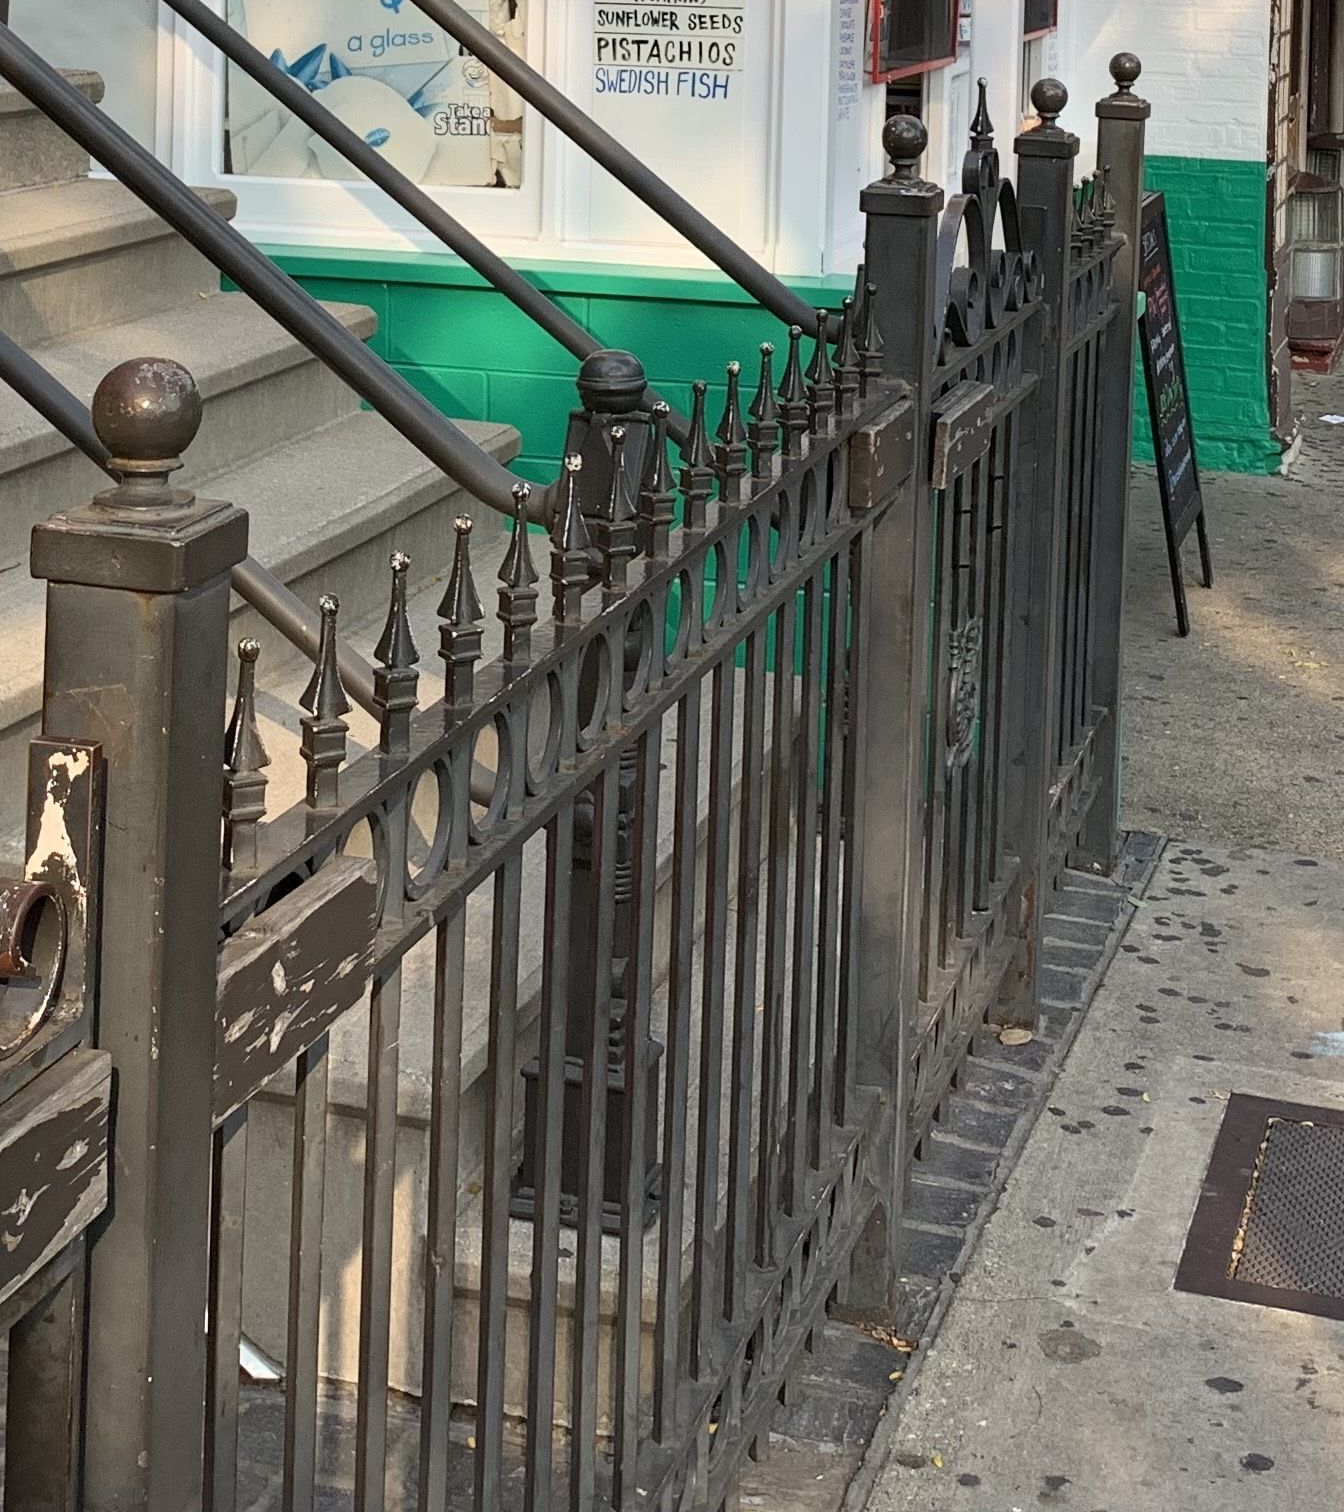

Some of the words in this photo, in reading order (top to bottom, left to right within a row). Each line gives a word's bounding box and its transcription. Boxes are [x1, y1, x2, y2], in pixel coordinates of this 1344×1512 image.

[597, 9, 680, 31] SUNFLOWER
[688, 13, 744, 35] SEEDS
[347, 33, 364, 53] a
[370, 28, 436, 58] glass
[597, 37, 736, 66] PISTACHIOS
[595, 68, 669, 95] SWEDISH
[676, 71, 730, 99] FISH
[434, 111, 491, 136] Stan
[448, 103, 481, 119] Take
